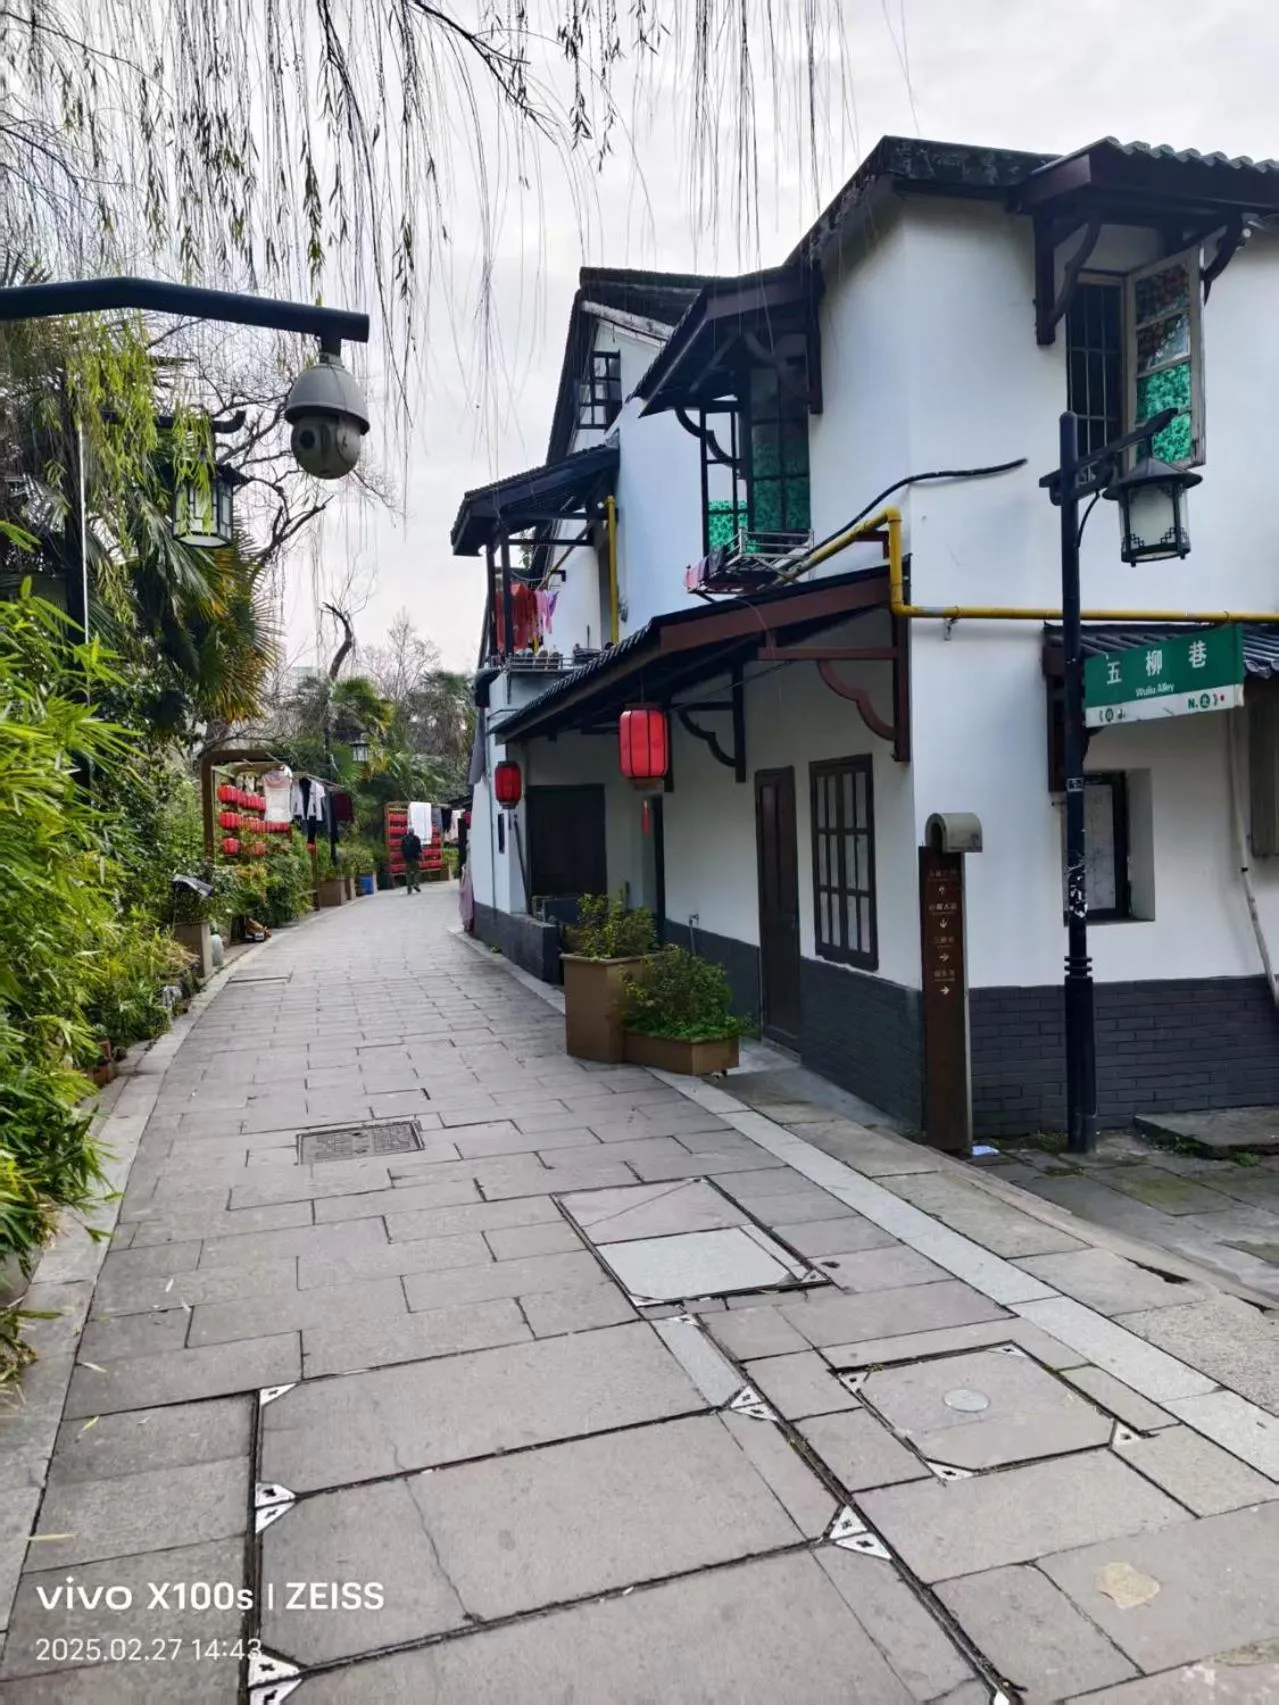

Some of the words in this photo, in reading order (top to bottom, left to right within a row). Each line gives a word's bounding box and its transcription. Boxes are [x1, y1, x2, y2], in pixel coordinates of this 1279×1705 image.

[1106, 640, 1208, 685] 五柳巷
[1157, 682, 1175, 693] Alley
